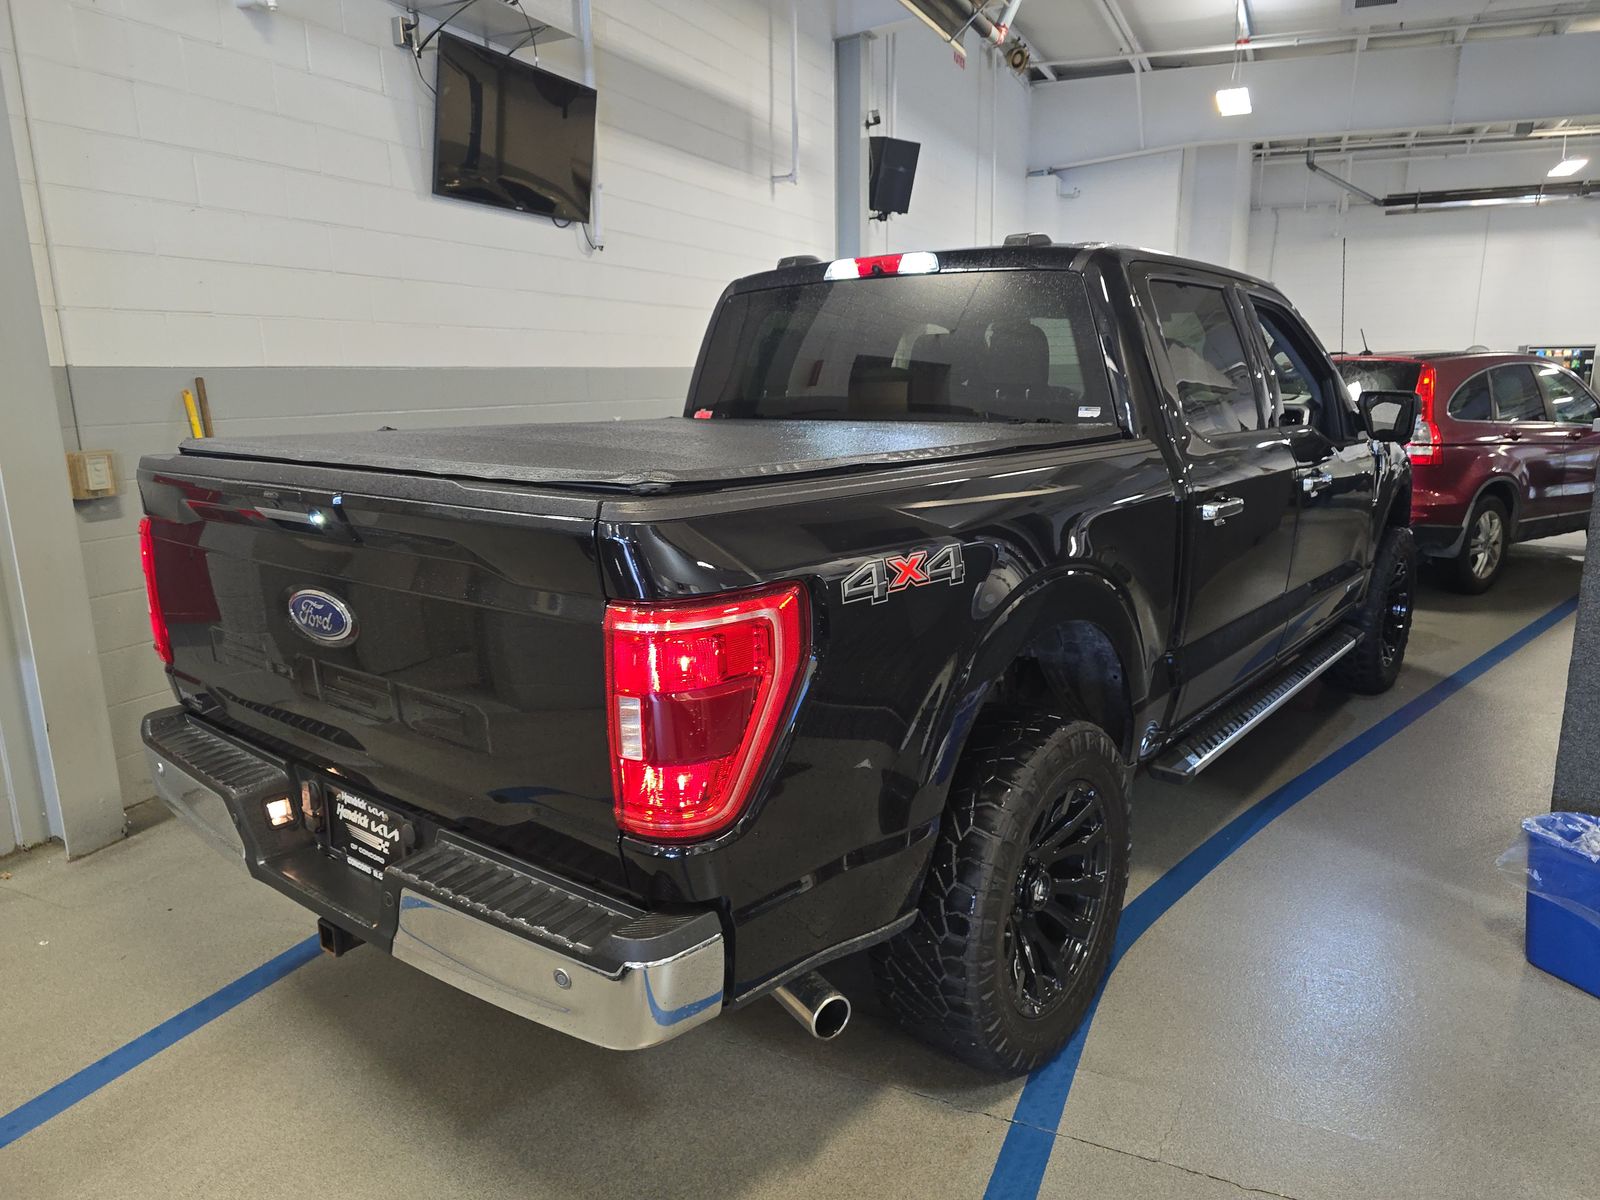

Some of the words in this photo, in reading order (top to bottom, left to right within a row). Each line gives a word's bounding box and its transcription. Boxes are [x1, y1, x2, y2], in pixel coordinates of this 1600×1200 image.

[299, 599, 333, 631] Ford
[341, 791, 367, 810] Hendrick
[336, 802, 369, 829] Hendrick
